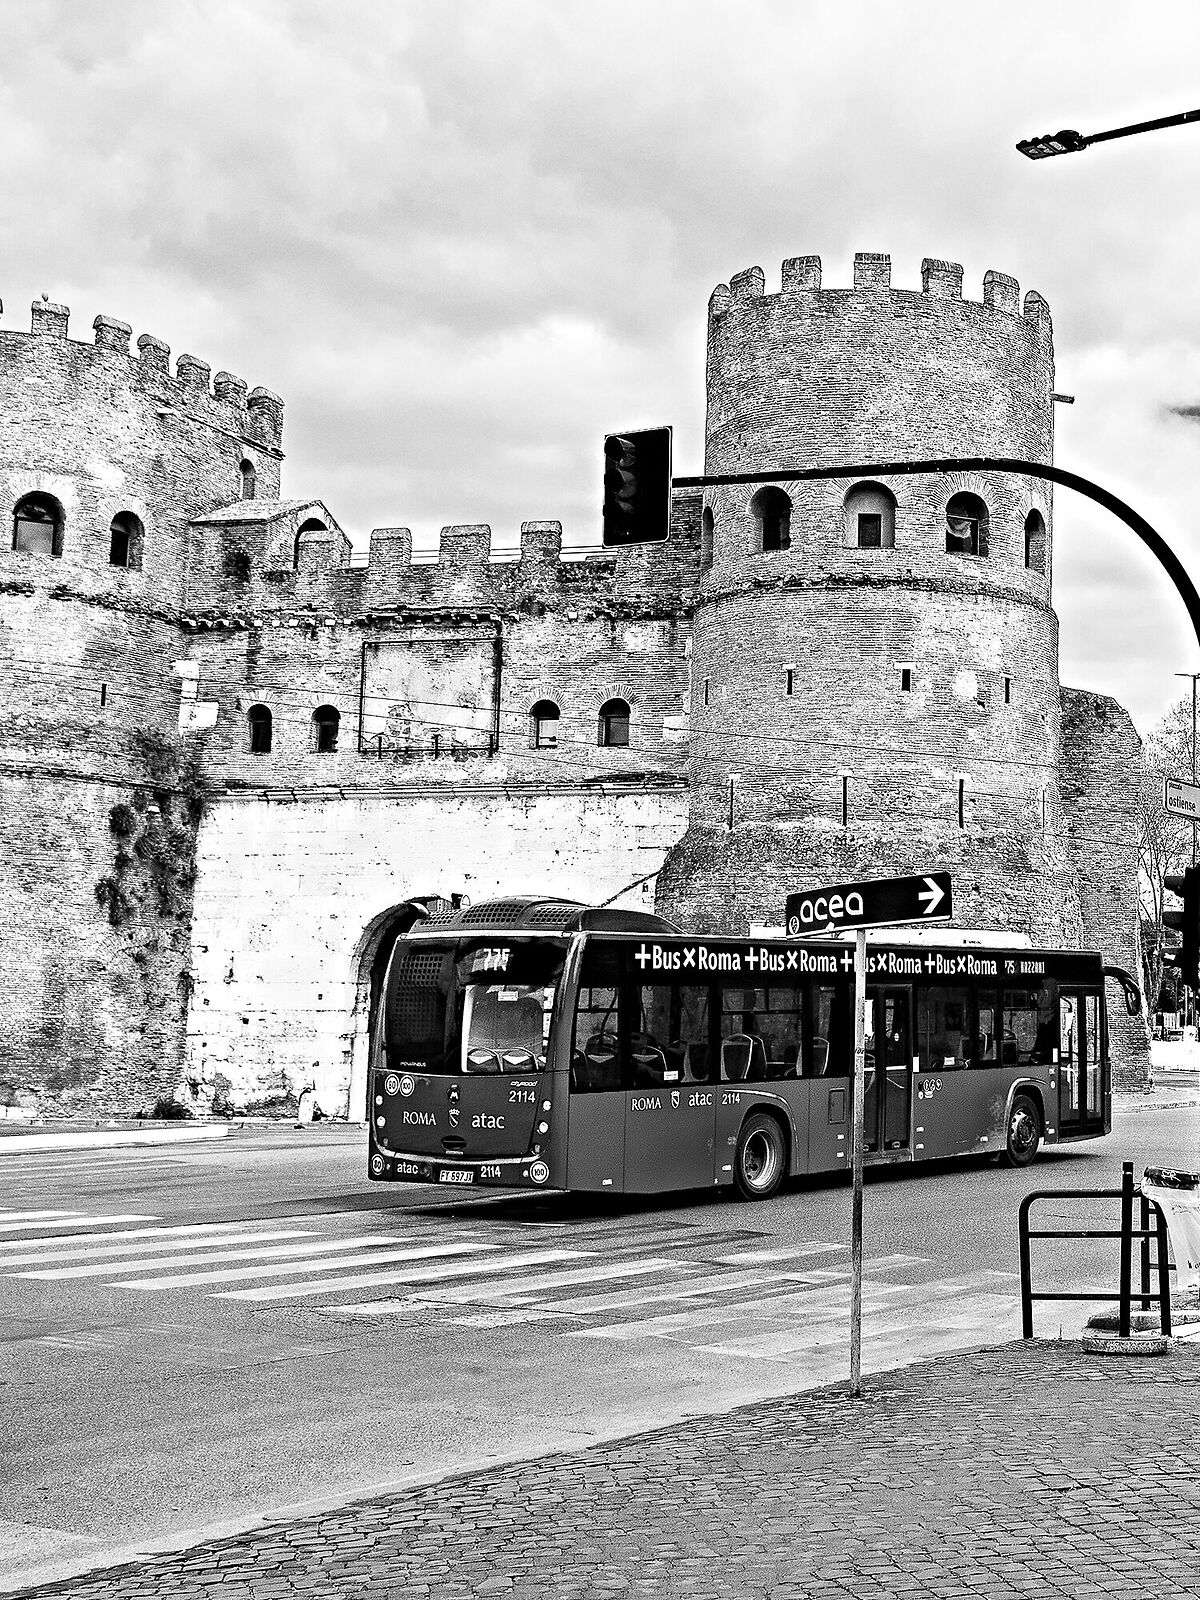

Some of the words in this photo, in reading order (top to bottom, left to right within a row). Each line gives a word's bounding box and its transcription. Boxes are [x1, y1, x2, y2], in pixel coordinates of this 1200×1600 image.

[800, 892, 864, 923] acea
[508, 1090, 536, 1103] 2114
[688, 1092, 713, 1107] atac
[722, 1093, 741, 1105] 2114
[631, 1097, 662, 1111] ROMA
[403, 1111, 437, 1126] ROMA
[471, 1113, 505, 1129] atac
[397, 1161, 419, 1175] atac
[480, 1165, 502, 1178] 2114
